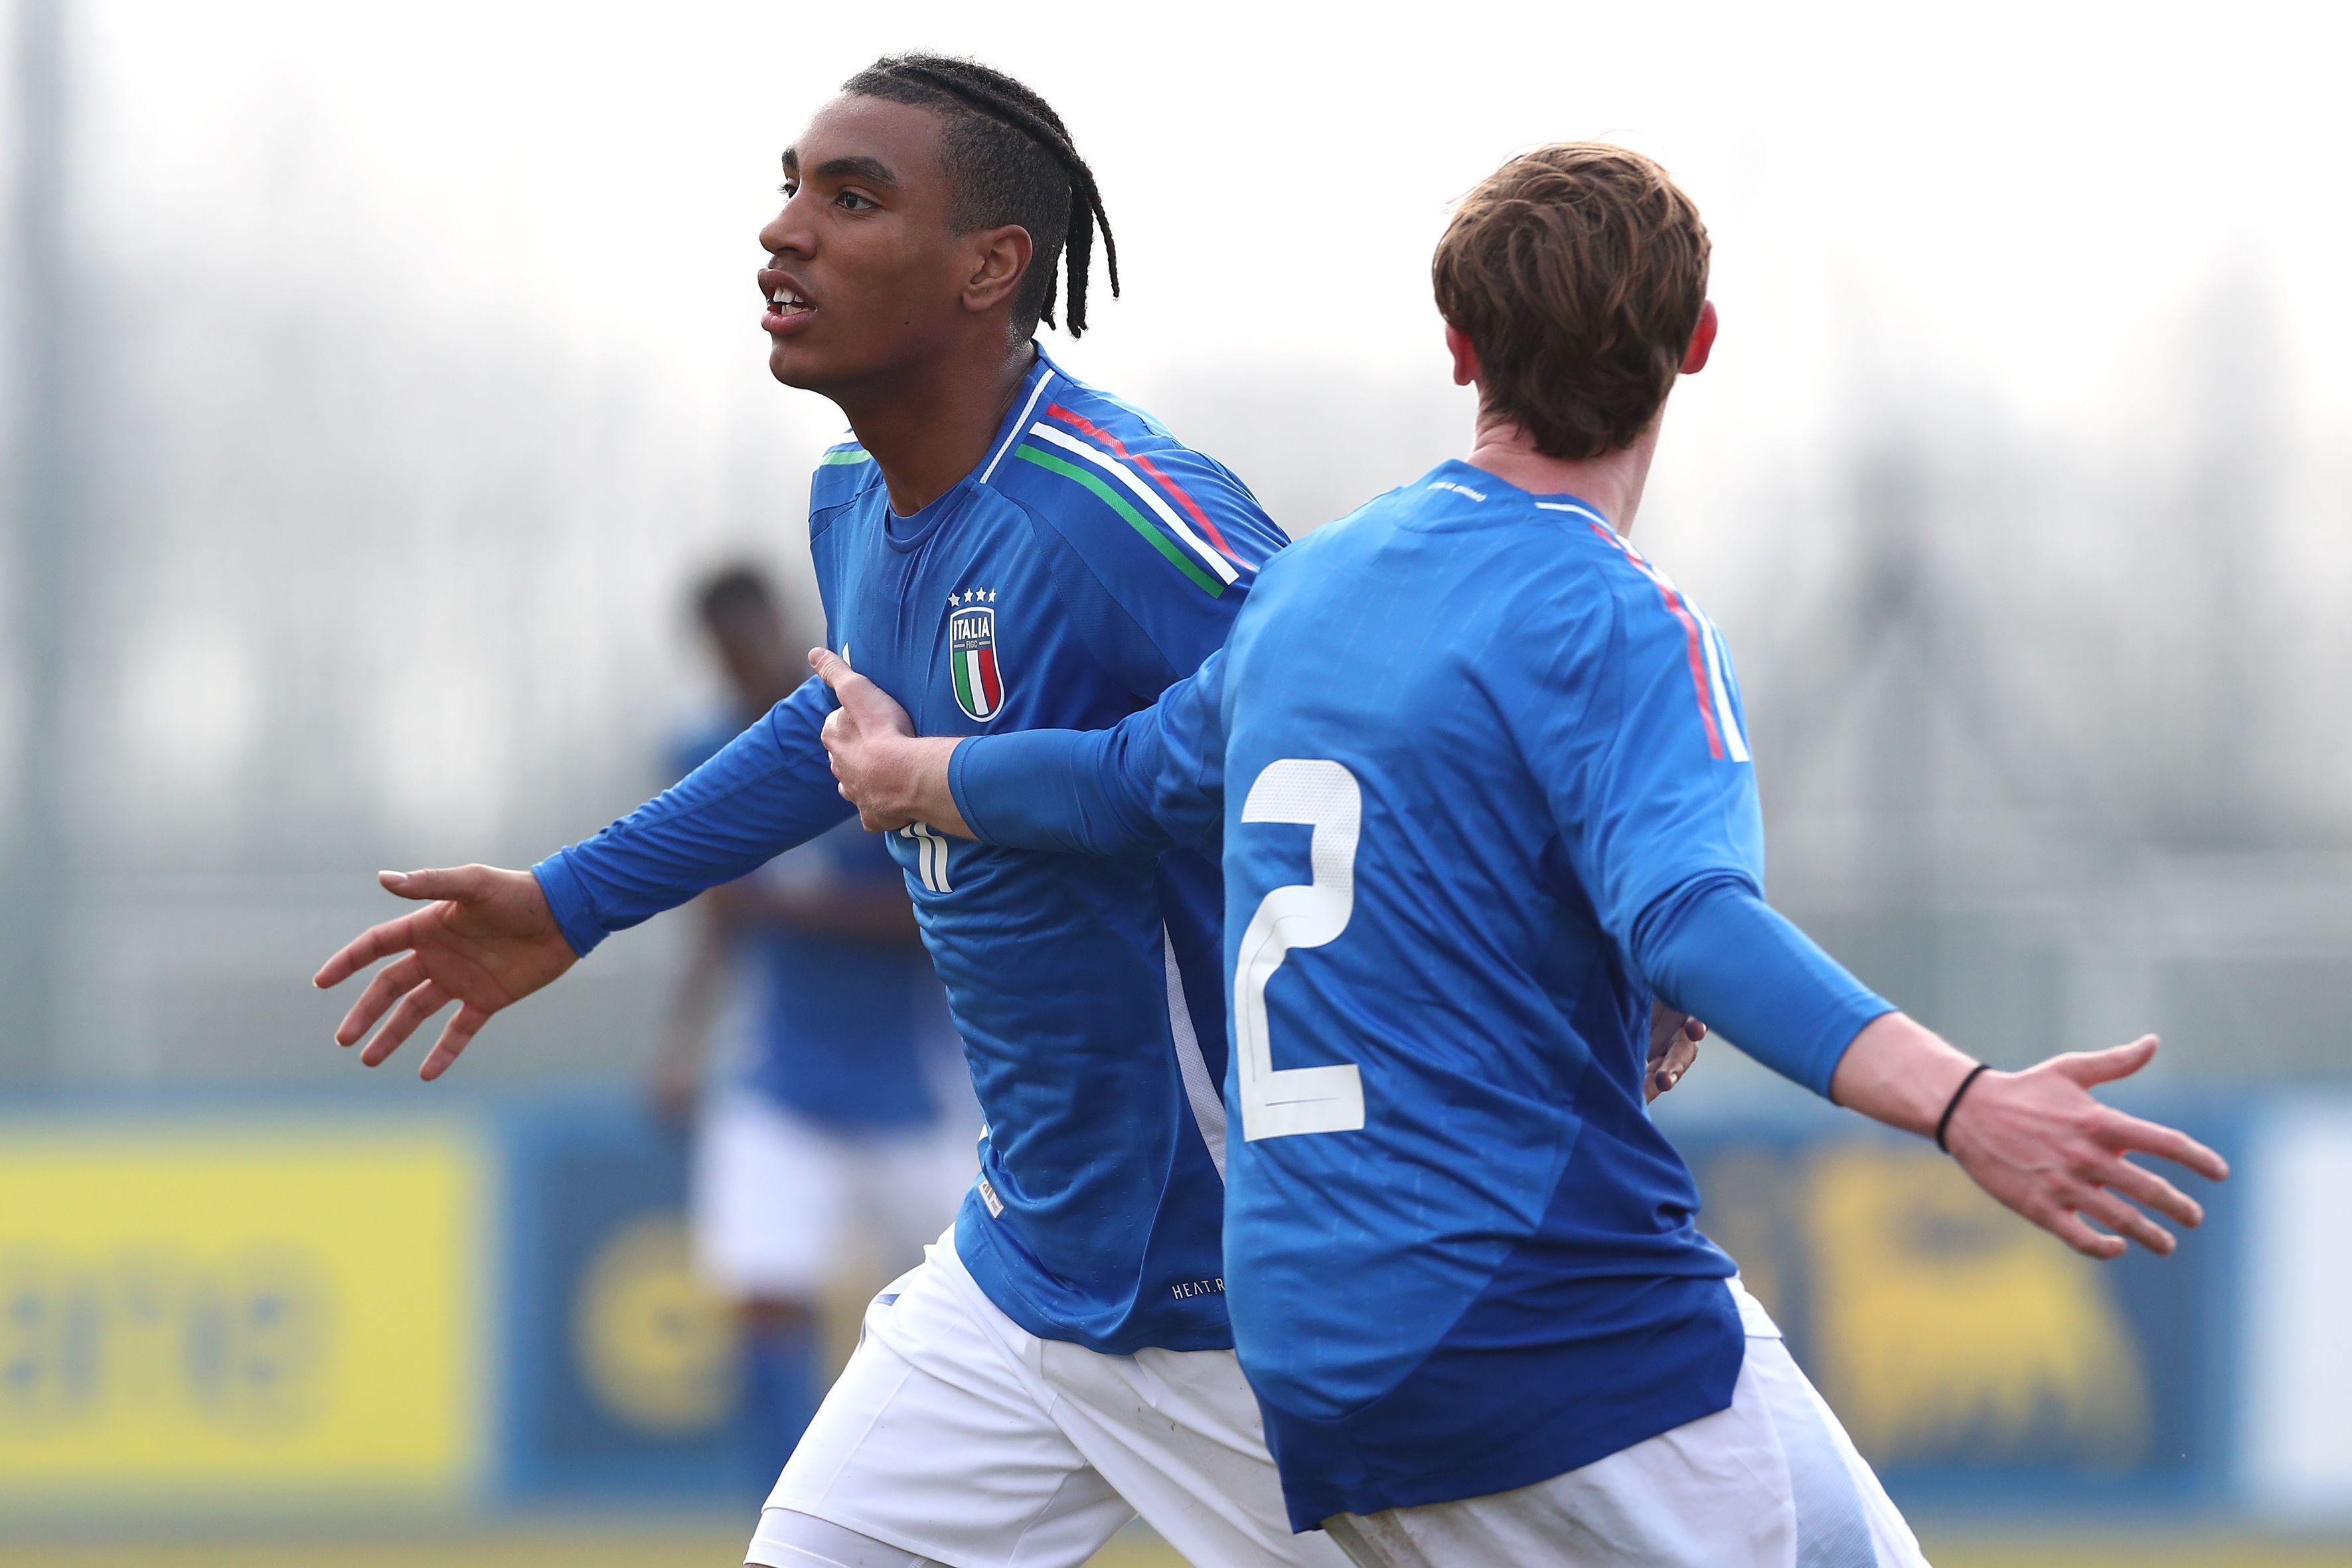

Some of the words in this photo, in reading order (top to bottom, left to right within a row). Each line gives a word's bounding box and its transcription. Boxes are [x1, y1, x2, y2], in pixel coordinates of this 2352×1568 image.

[954, 616, 990, 641] ITALIA
[966, 639, 978, 649] FIGC
[1233, 758, 1366, 1142] 2
